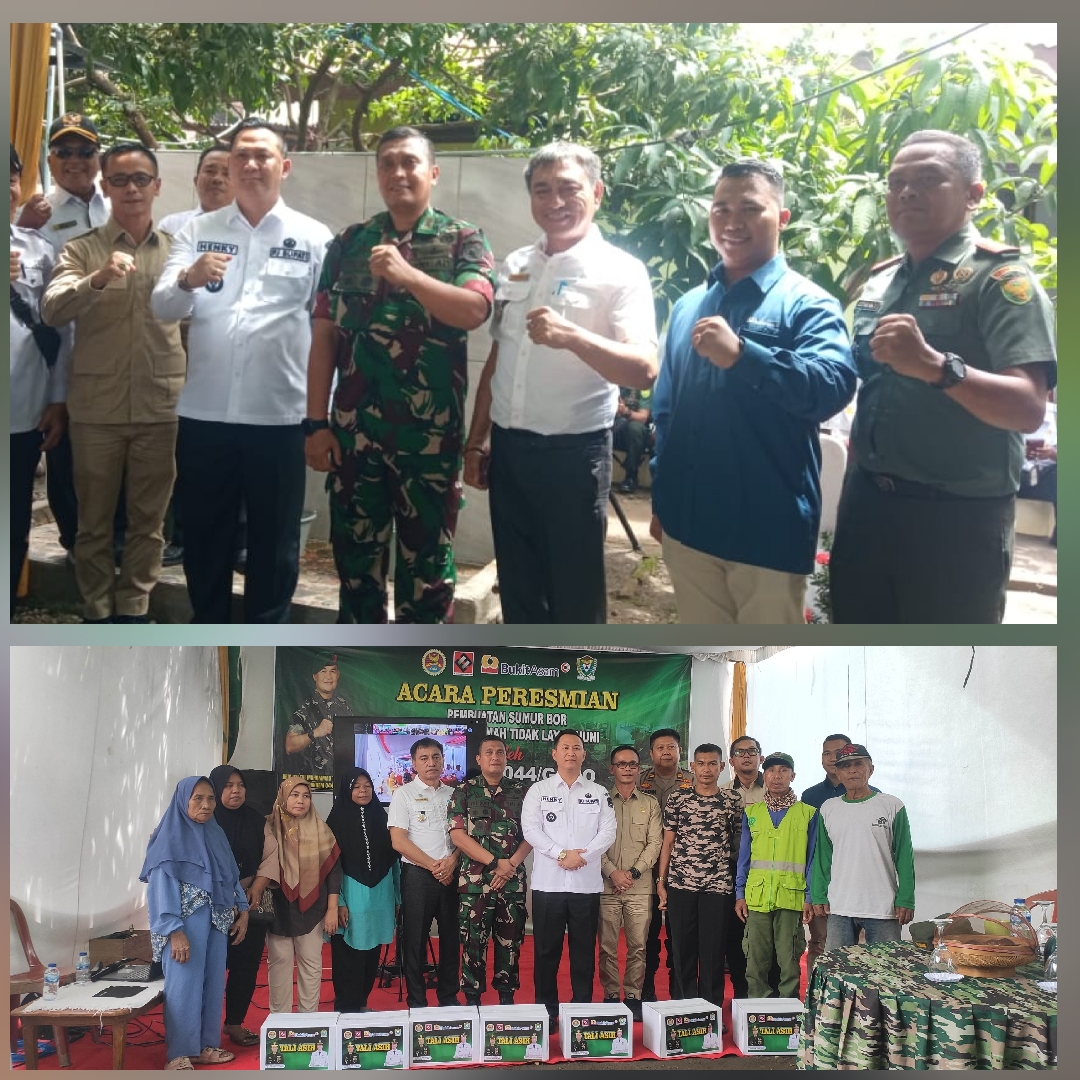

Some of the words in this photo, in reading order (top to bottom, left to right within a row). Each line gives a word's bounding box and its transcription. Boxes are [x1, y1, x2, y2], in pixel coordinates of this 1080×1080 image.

[501, 662, 559, 677] BukitAsam
[396, 682, 475, 704] ACARA
[481, 686, 618, 710] PERESMIAN
[508, 711, 543, 725] SUMUR
[547, 713, 567, 726] BOR
[510, 728, 539, 741] TIDAK
